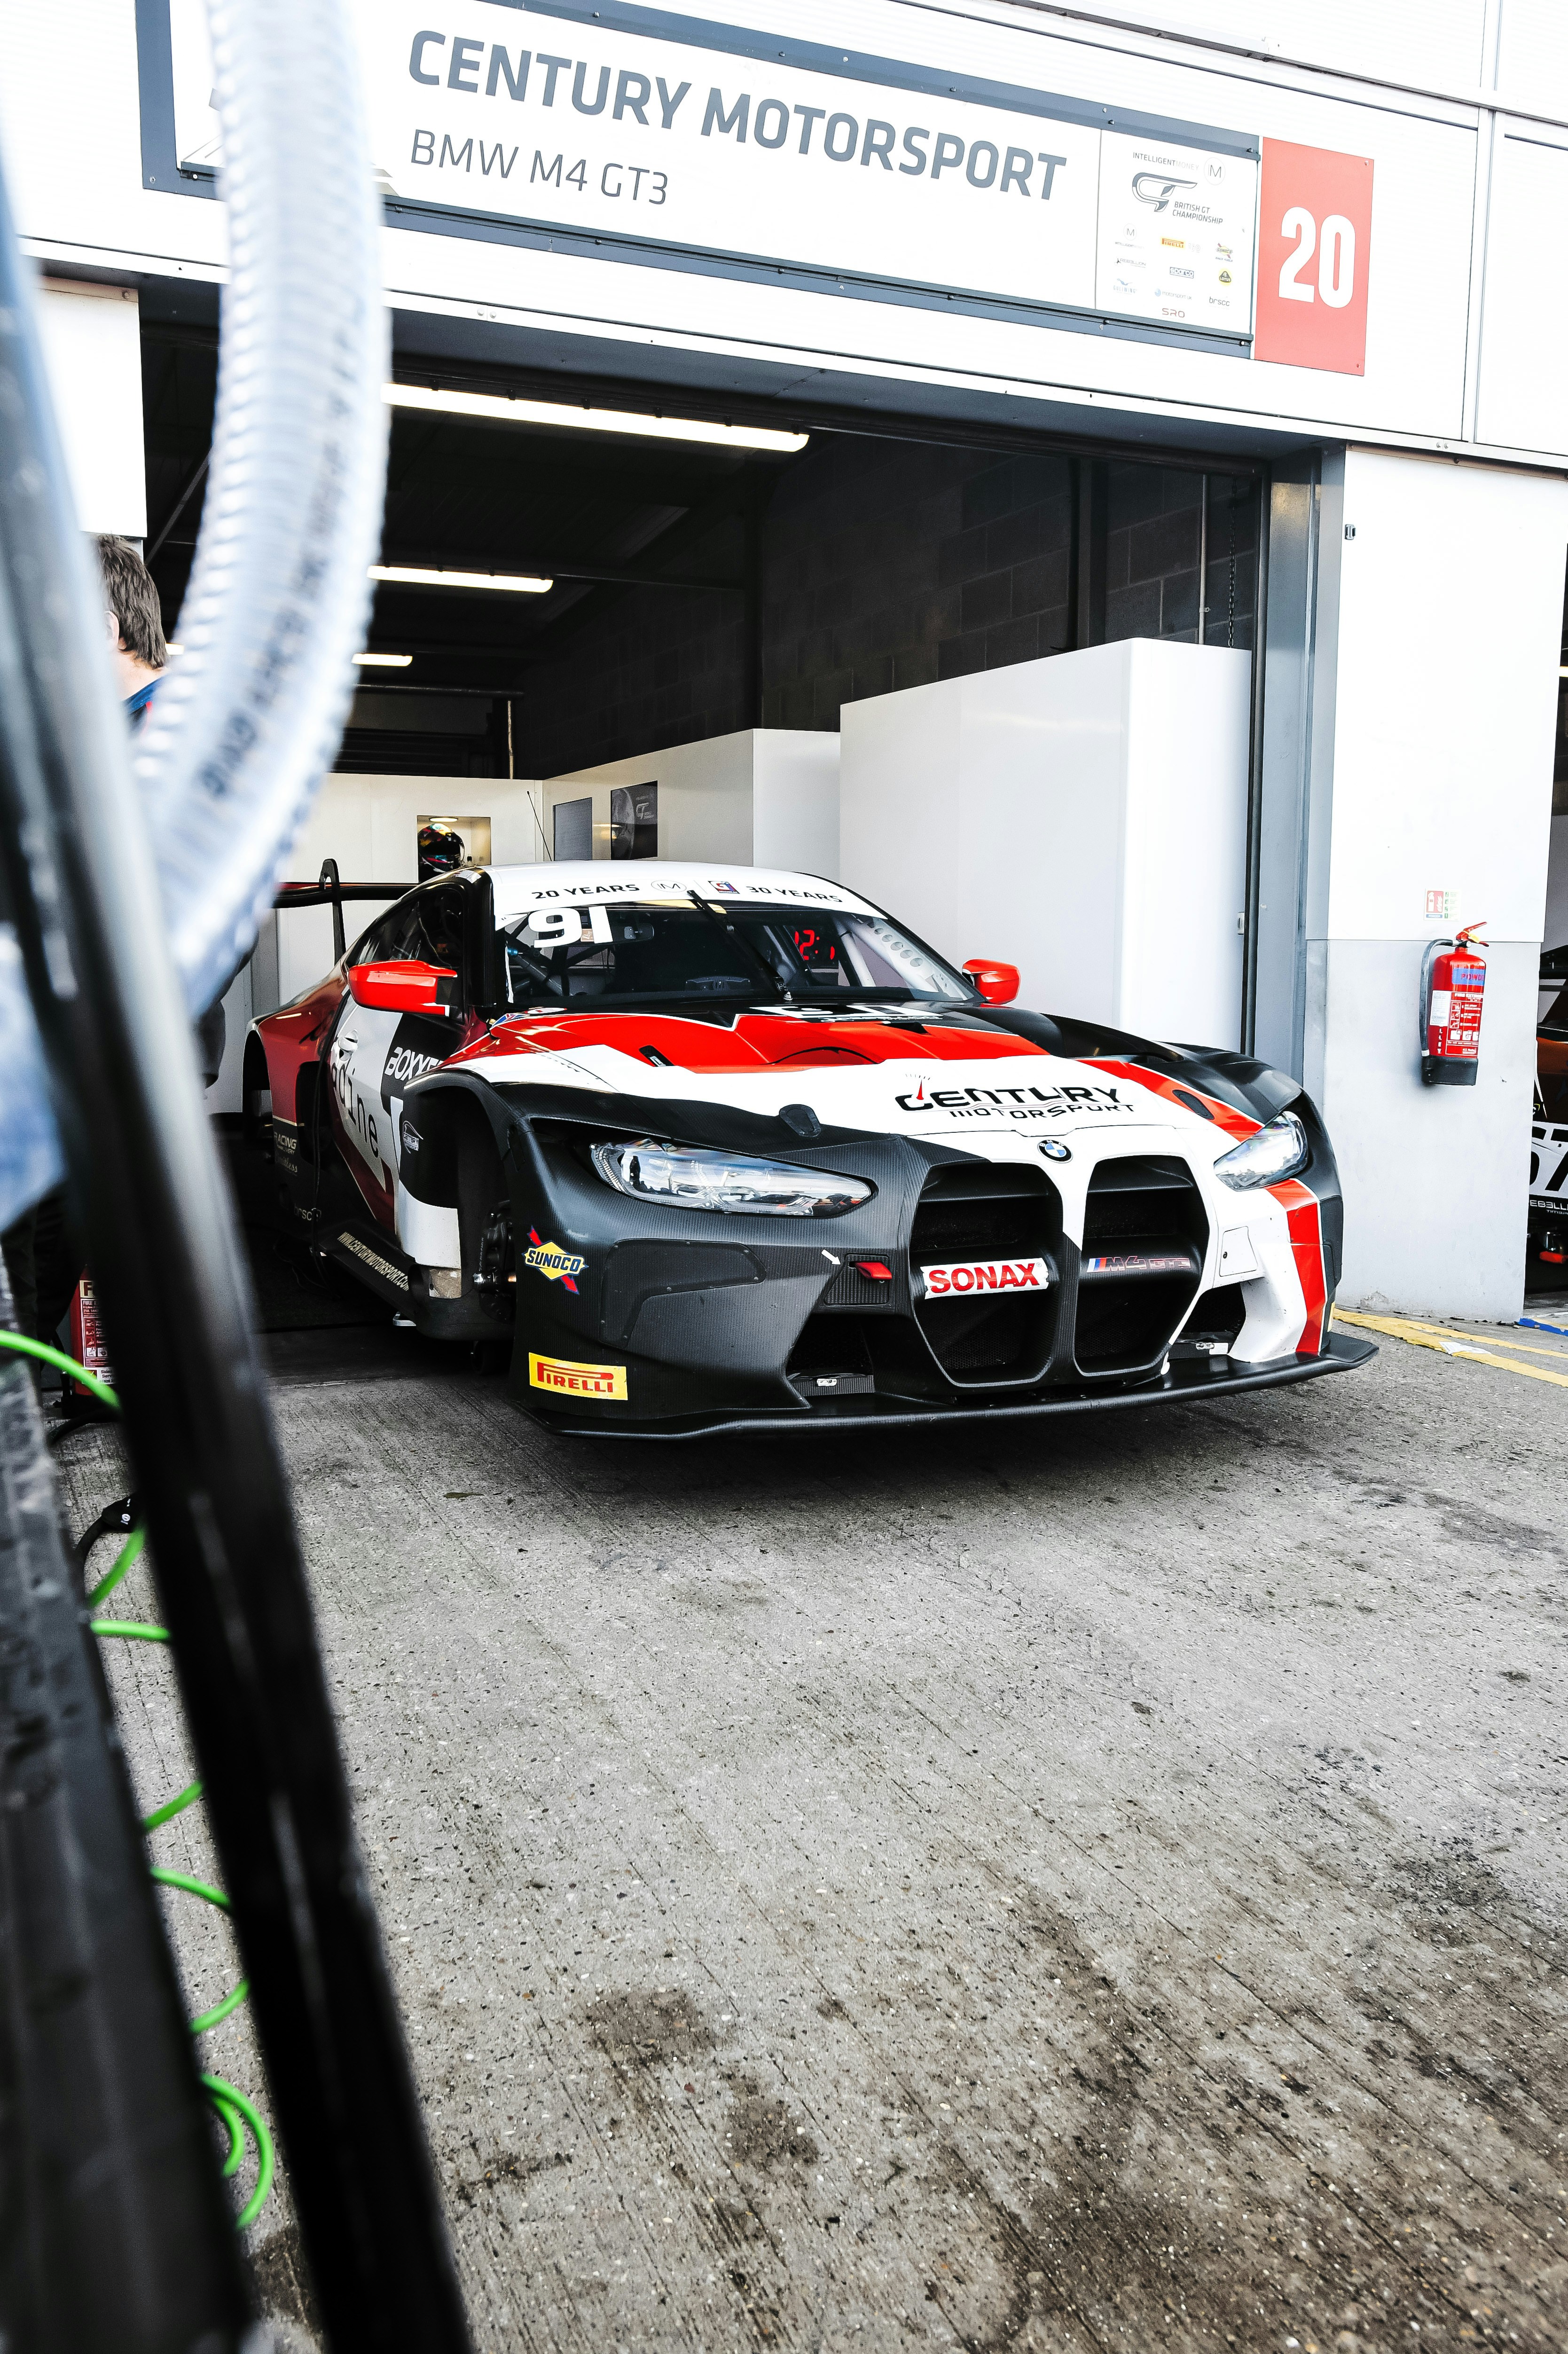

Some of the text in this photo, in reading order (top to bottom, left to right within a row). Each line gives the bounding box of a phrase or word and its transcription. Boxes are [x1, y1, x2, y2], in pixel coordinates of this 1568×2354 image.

[409, 30, 1067, 200] CENTURY MOTORSPORT
[411, 129, 668, 205] BMW M4 GT3
[1174, 201, 1200, 212] BRITISH
[1173, 209, 1223, 225] CHAMPIONSHIP
[1162, 238, 1184, 248] PIRELLI
[1278, 206, 1356, 309] 20
[1209, 296, 1230, 306] brscc
[1162, 308, 1185, 318] SRO
[532, 884, 640, 899] 20 YEARS
[745, 886, 772, 894] 30
[773, 888, 843, 903] YEARS
[528, 907, 613, 948] 91
[895, 1084, 1121, 1111] CENTURY
[949, 1105, 1135, 1119] MOTORSPORT
[274, 1131, 298, 1150] RACING
[527, 1250, 581, 1272] SUNOCO
[1105, 1255, 1192, 1271] M4 GT3
[929, 1263, 1040, 1294] SONAX
[537, 1361, 614, 1393] PIRELLI
